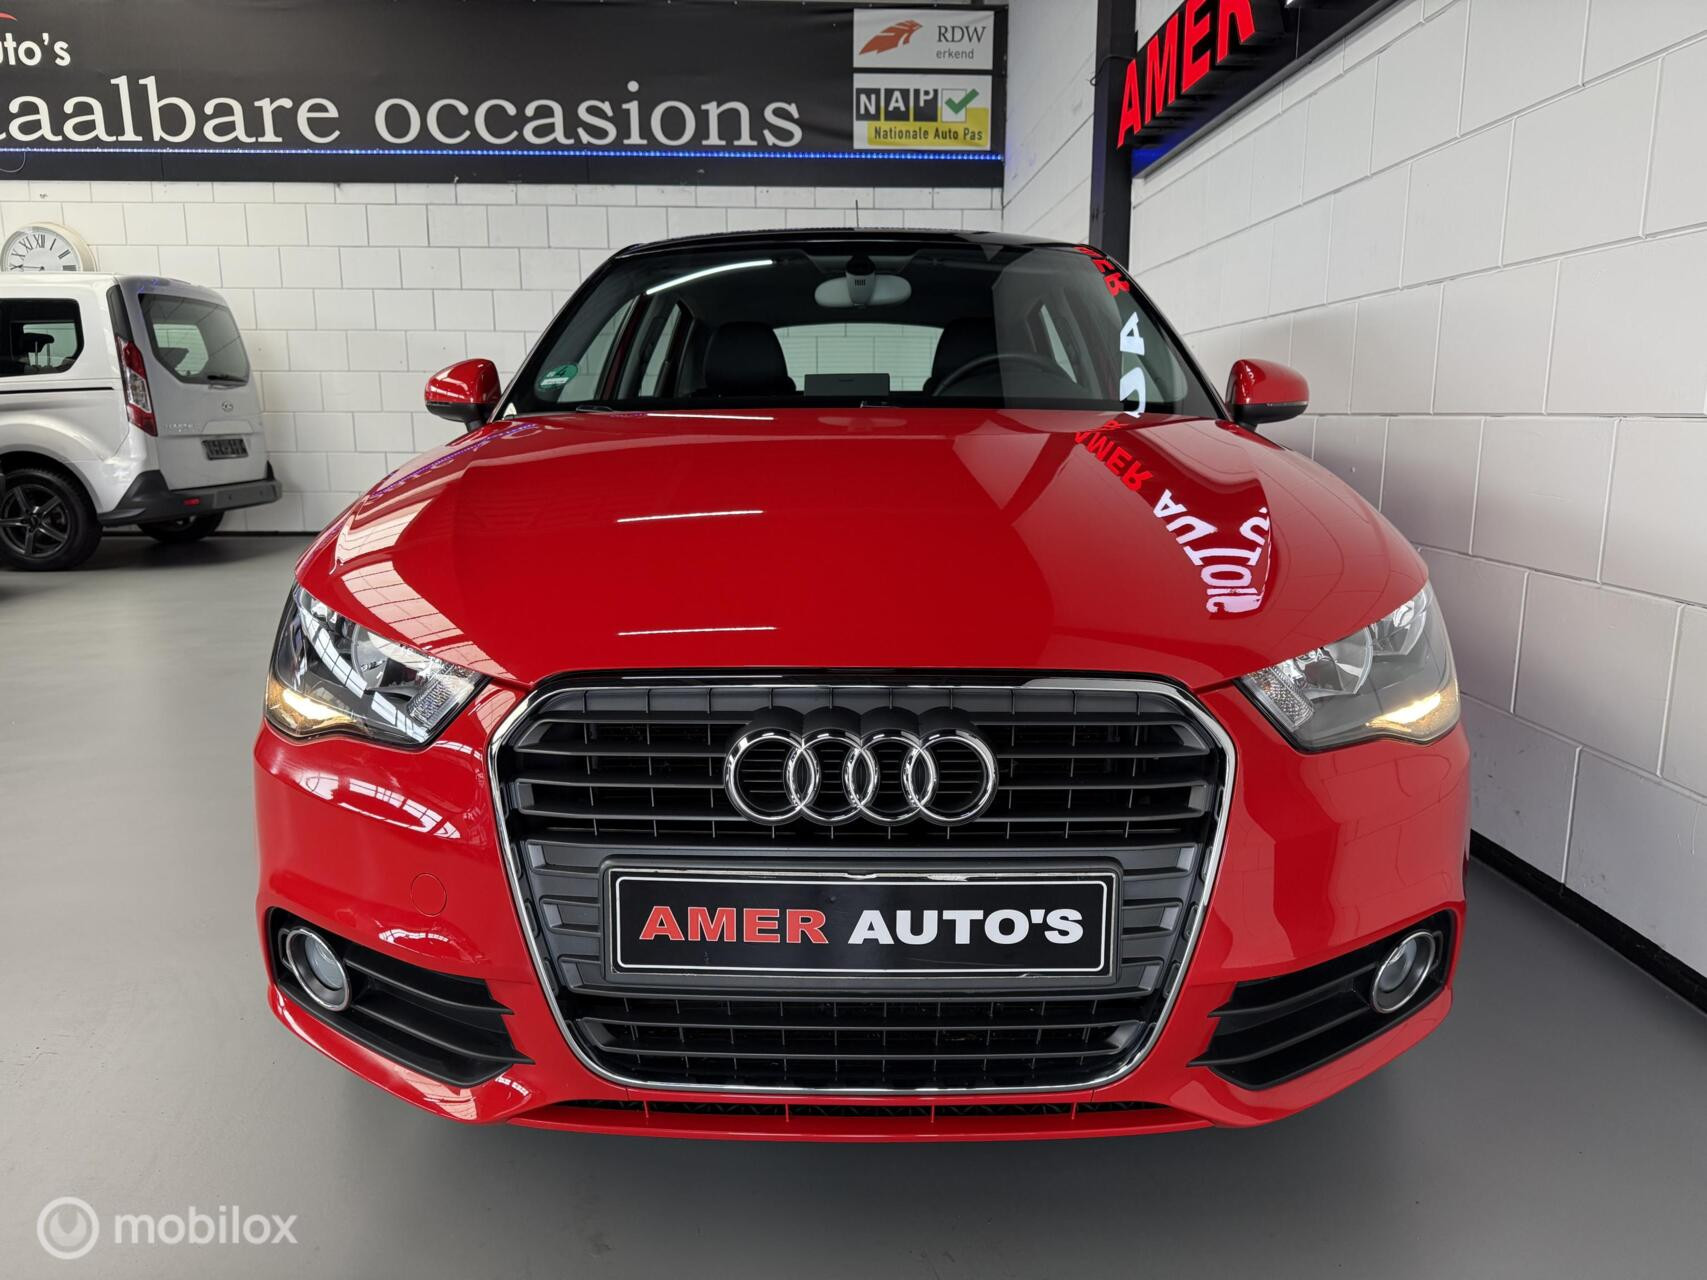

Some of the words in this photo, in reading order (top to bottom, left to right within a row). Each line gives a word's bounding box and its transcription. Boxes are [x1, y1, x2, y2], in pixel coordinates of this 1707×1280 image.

[937, 25, 987, 43] RDW
[936, 49, 974, 59] erkend
[0, 75, 340, 143] aalbare
[374, 80, 802, 147] occasions
[874, 126, 929, 140] Nationale
[933, 127, 959, 140] Auto
[963, 128, 983, 140] Pas
[639, 905, 829, 944] AMER
[847, 908, 1084, 945] AUTO'S
